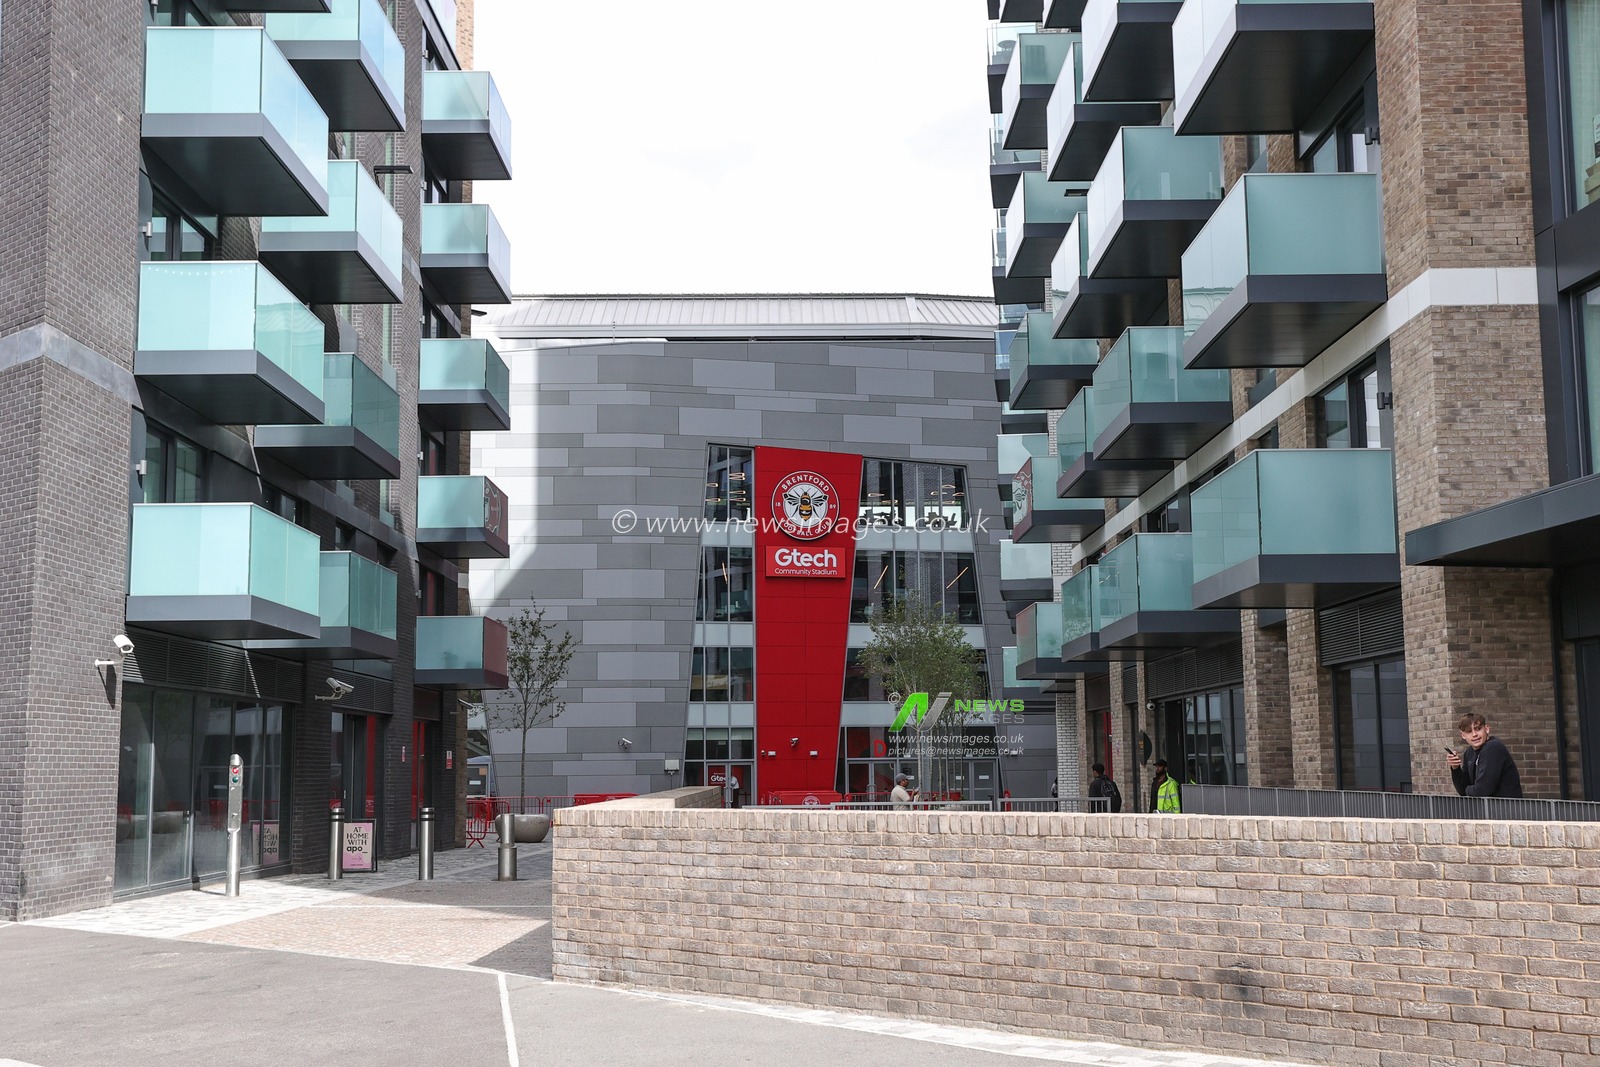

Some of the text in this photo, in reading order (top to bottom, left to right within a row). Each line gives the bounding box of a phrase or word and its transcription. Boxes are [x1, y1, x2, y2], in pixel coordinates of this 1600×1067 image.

[781, 474, 829, 492] BRENTFORD
[774, 548, 837, 568] Gtech
[774, 567, 837, 576] Community Stadium
